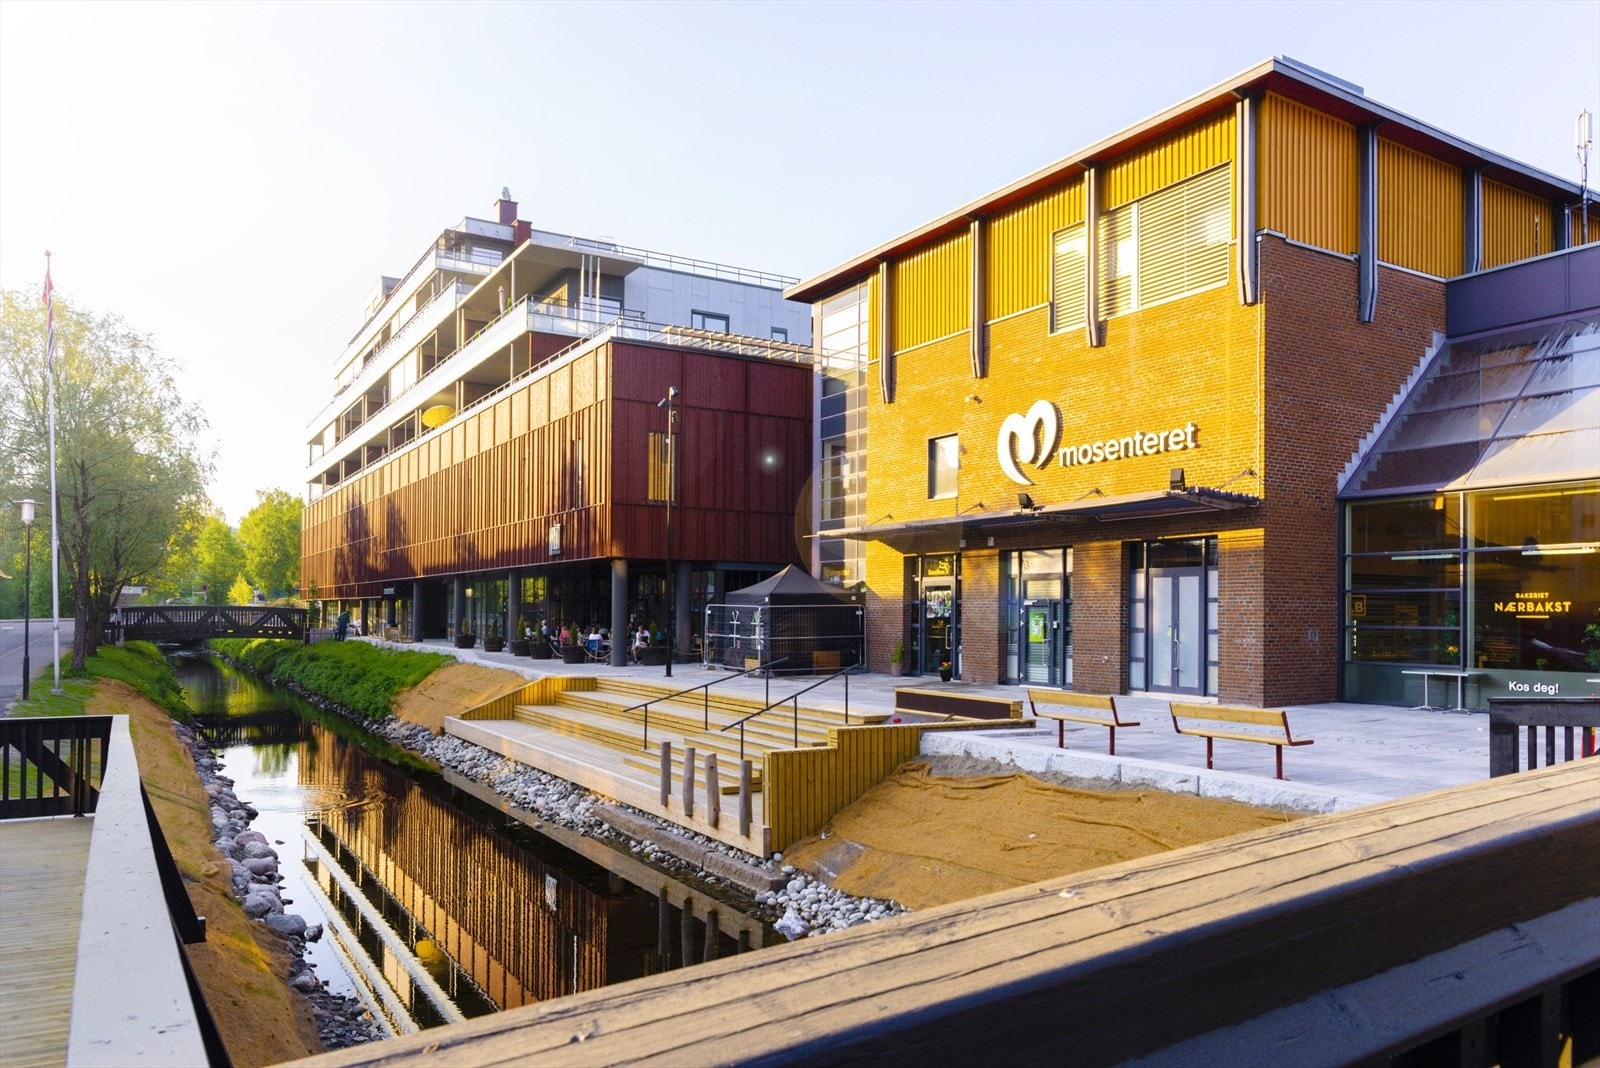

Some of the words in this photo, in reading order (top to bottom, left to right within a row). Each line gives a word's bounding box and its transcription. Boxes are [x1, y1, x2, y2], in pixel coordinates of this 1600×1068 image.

[1058, 421, 1197, 467] mosenteret
[1494, 601, 1572, 612] NÆRBAKST
[1508, 681, 1530, 692] Kos
[1533, 682, 1559, 695] deg!
